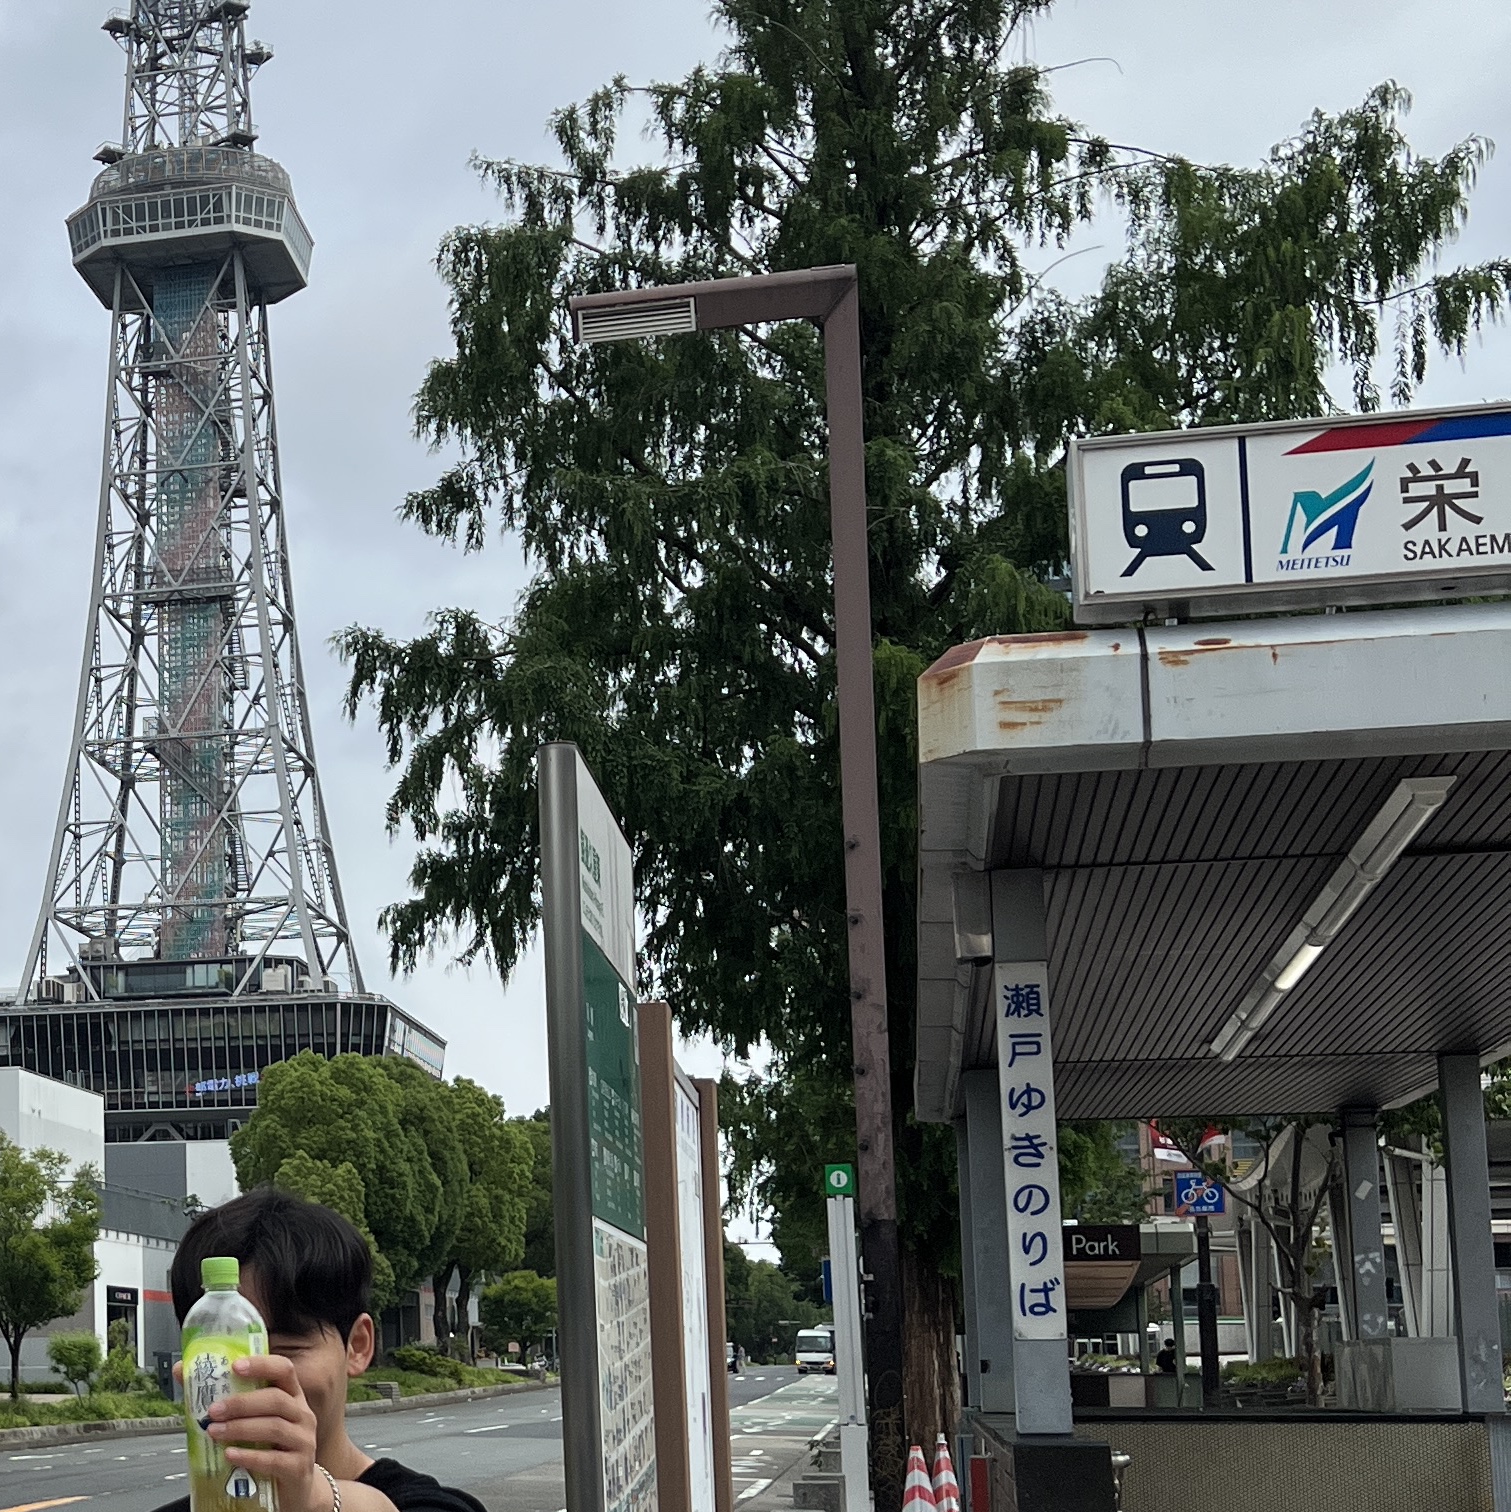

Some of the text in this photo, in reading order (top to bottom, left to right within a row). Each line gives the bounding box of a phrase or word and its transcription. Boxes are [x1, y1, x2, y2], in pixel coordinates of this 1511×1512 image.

[1400, 457, 1484, 532] 栄
[1403, 533, 1511, 561] SAKAEM
[1276, 554, 1351, 572] MEITETSU
[1003, 984, 1060, 1316] 瀬戸ゆきのりば
[1072, 1234, 1120, 1255] Park
